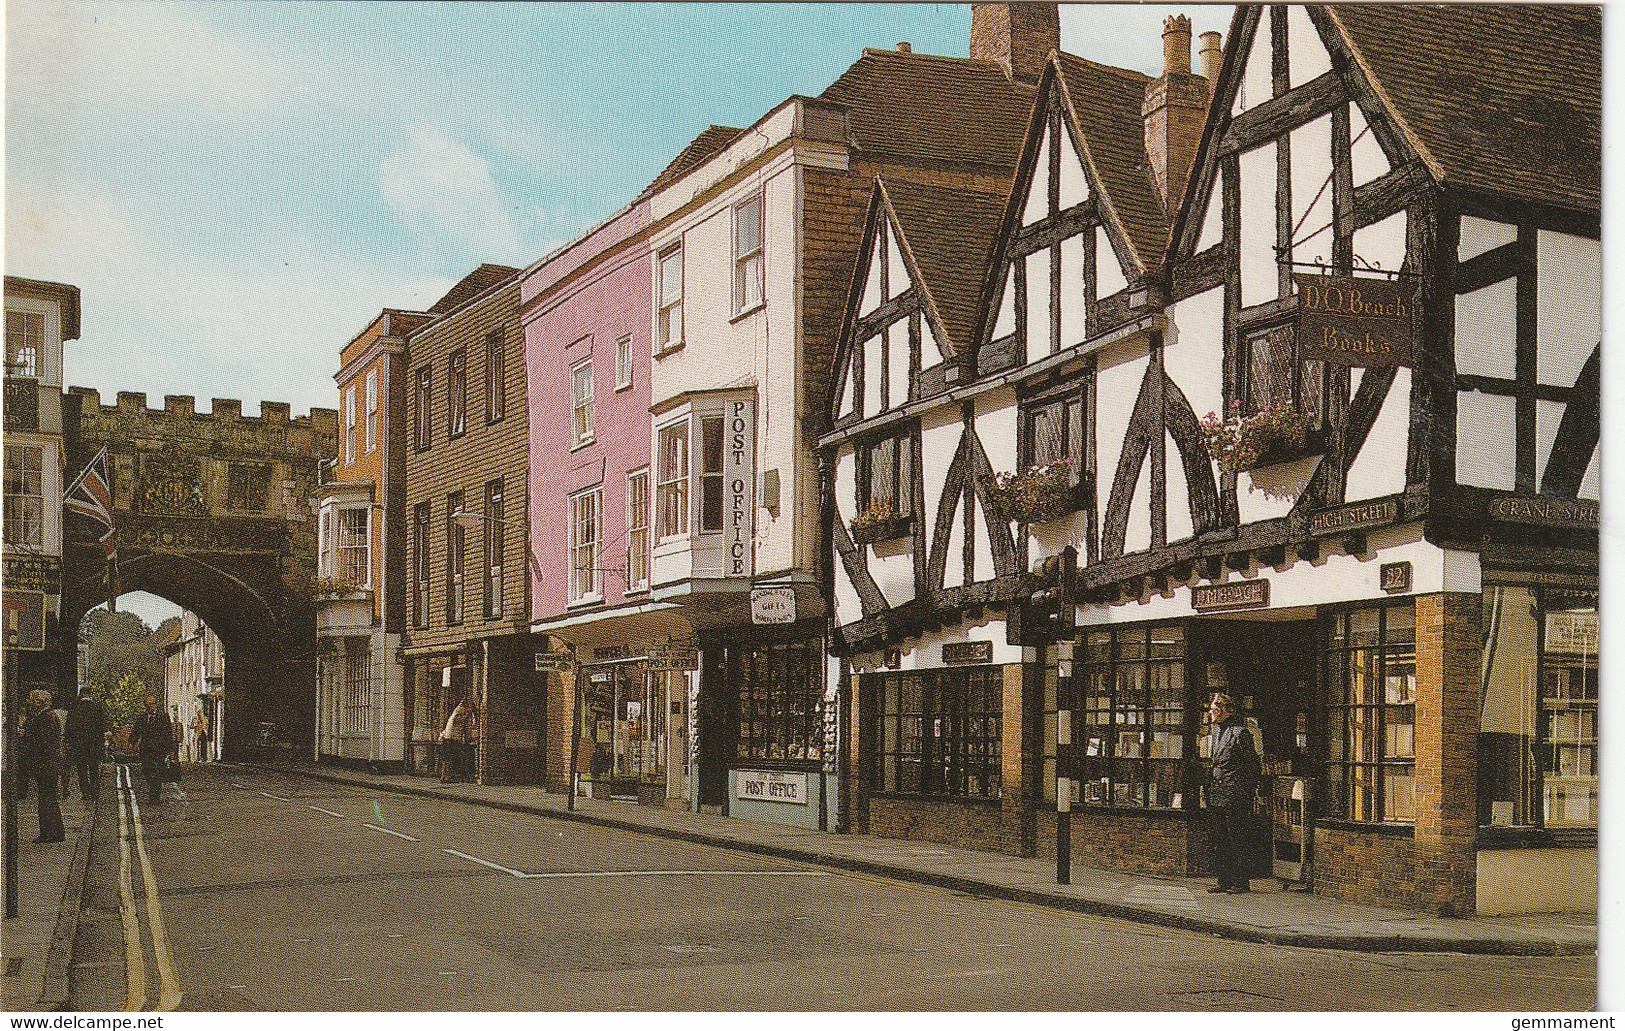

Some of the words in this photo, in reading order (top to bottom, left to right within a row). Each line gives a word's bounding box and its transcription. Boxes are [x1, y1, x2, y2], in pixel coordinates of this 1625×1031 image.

[1320, 326, 1391, 353] Books
[731, 401, 746, 464] POST
[1313, 512, 1344, 531] HIGH
[1350, 502, 1389, 523] STREET
[1498, 501, 1551, 519] CRANE
[730, 479, 745, 575] OFFICE
[745, 780, 765, 796] POST
[769, 782, 798, 798] OFFICE
